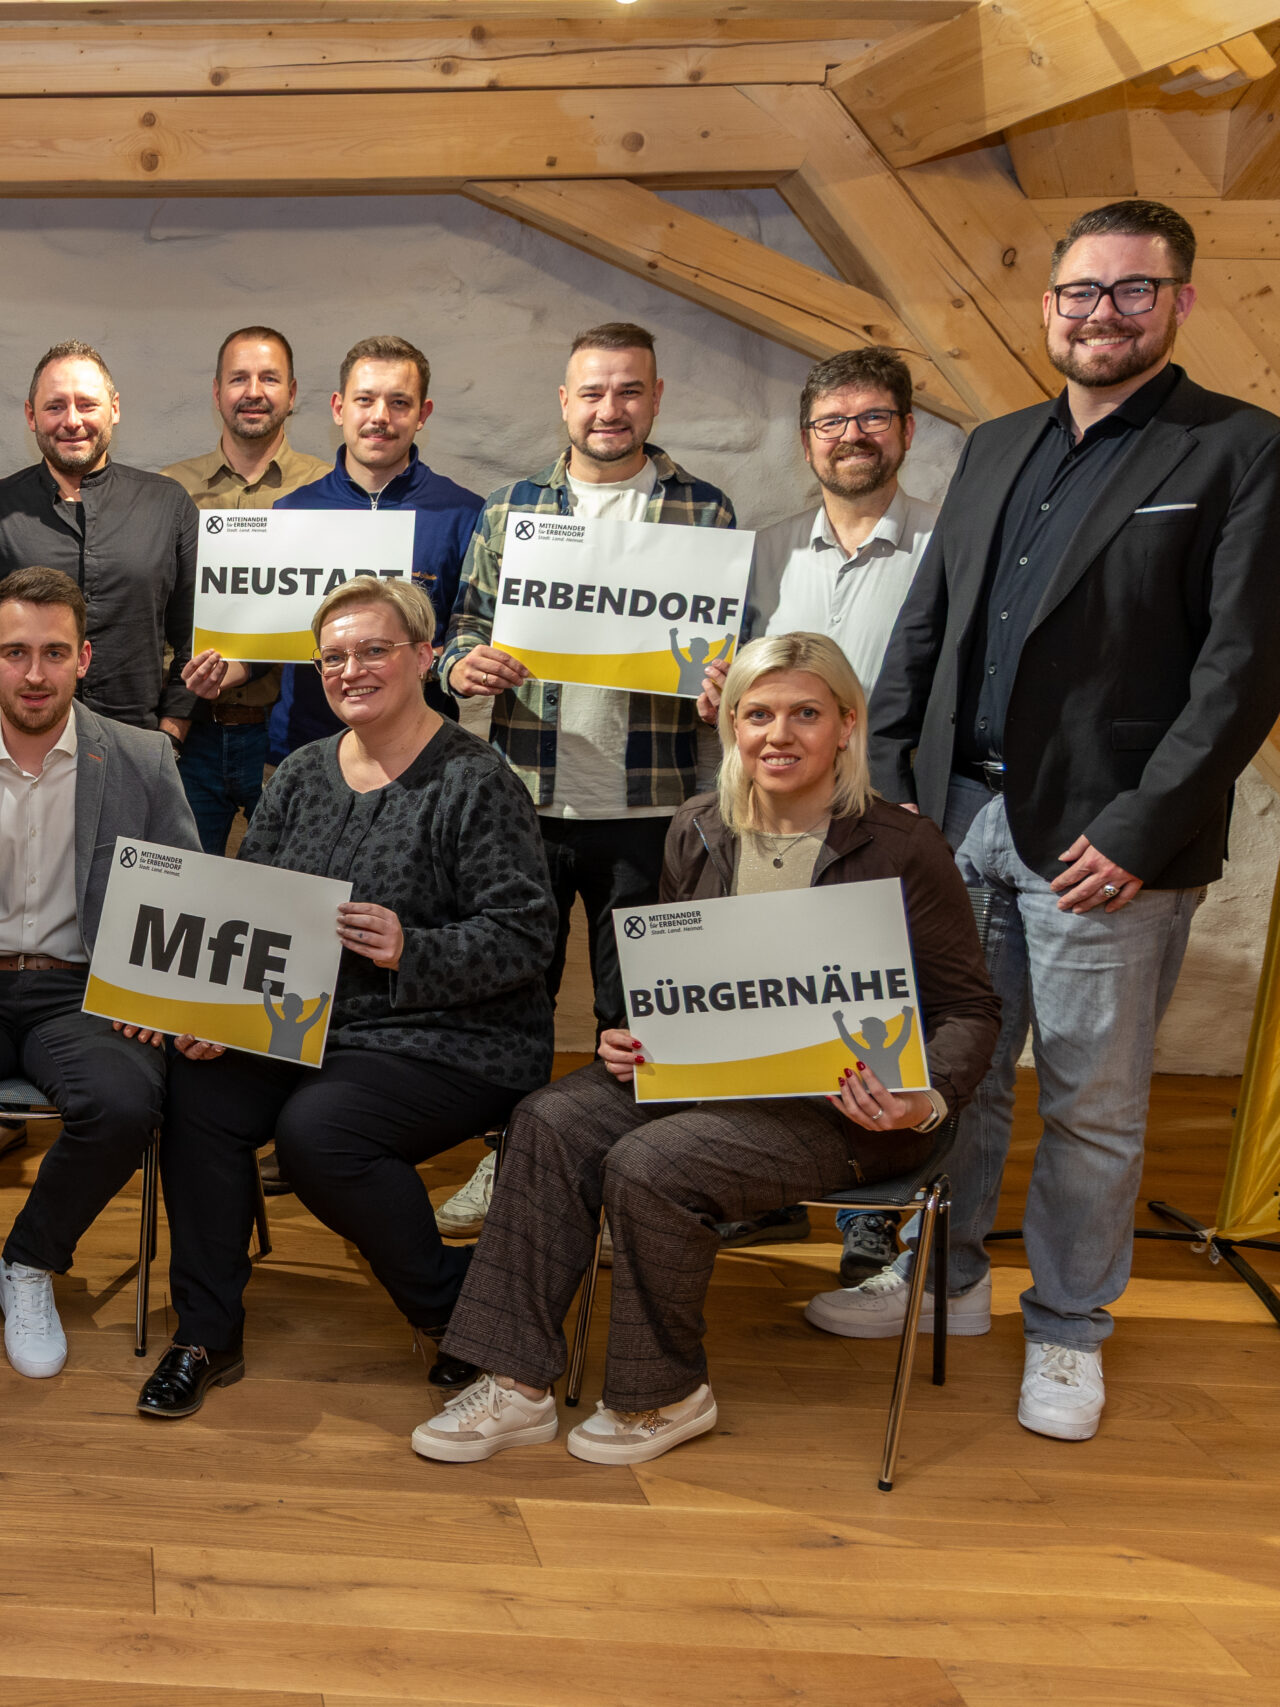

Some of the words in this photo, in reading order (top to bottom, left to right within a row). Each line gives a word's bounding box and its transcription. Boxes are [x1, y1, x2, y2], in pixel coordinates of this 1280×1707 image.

[539, 523, 586, 531] MITEINANDER
[546, 530, 585, 538] ERBENDORF
[201, 567, 404, 596] NEUSTAT
[502, 579, 739, 626] ERBENDORF
[141, 851, 183, 864] MITEINANDER
[147, 859, 182, 871] ERBENDORF
[649, 910, 701, 922] MITEINANDER
[658, 917, 702, 928] ERBENDORF
[129, 904, 293, 998] MfE
[630, 965, 910, 1018] BÜRGERNÄHE
